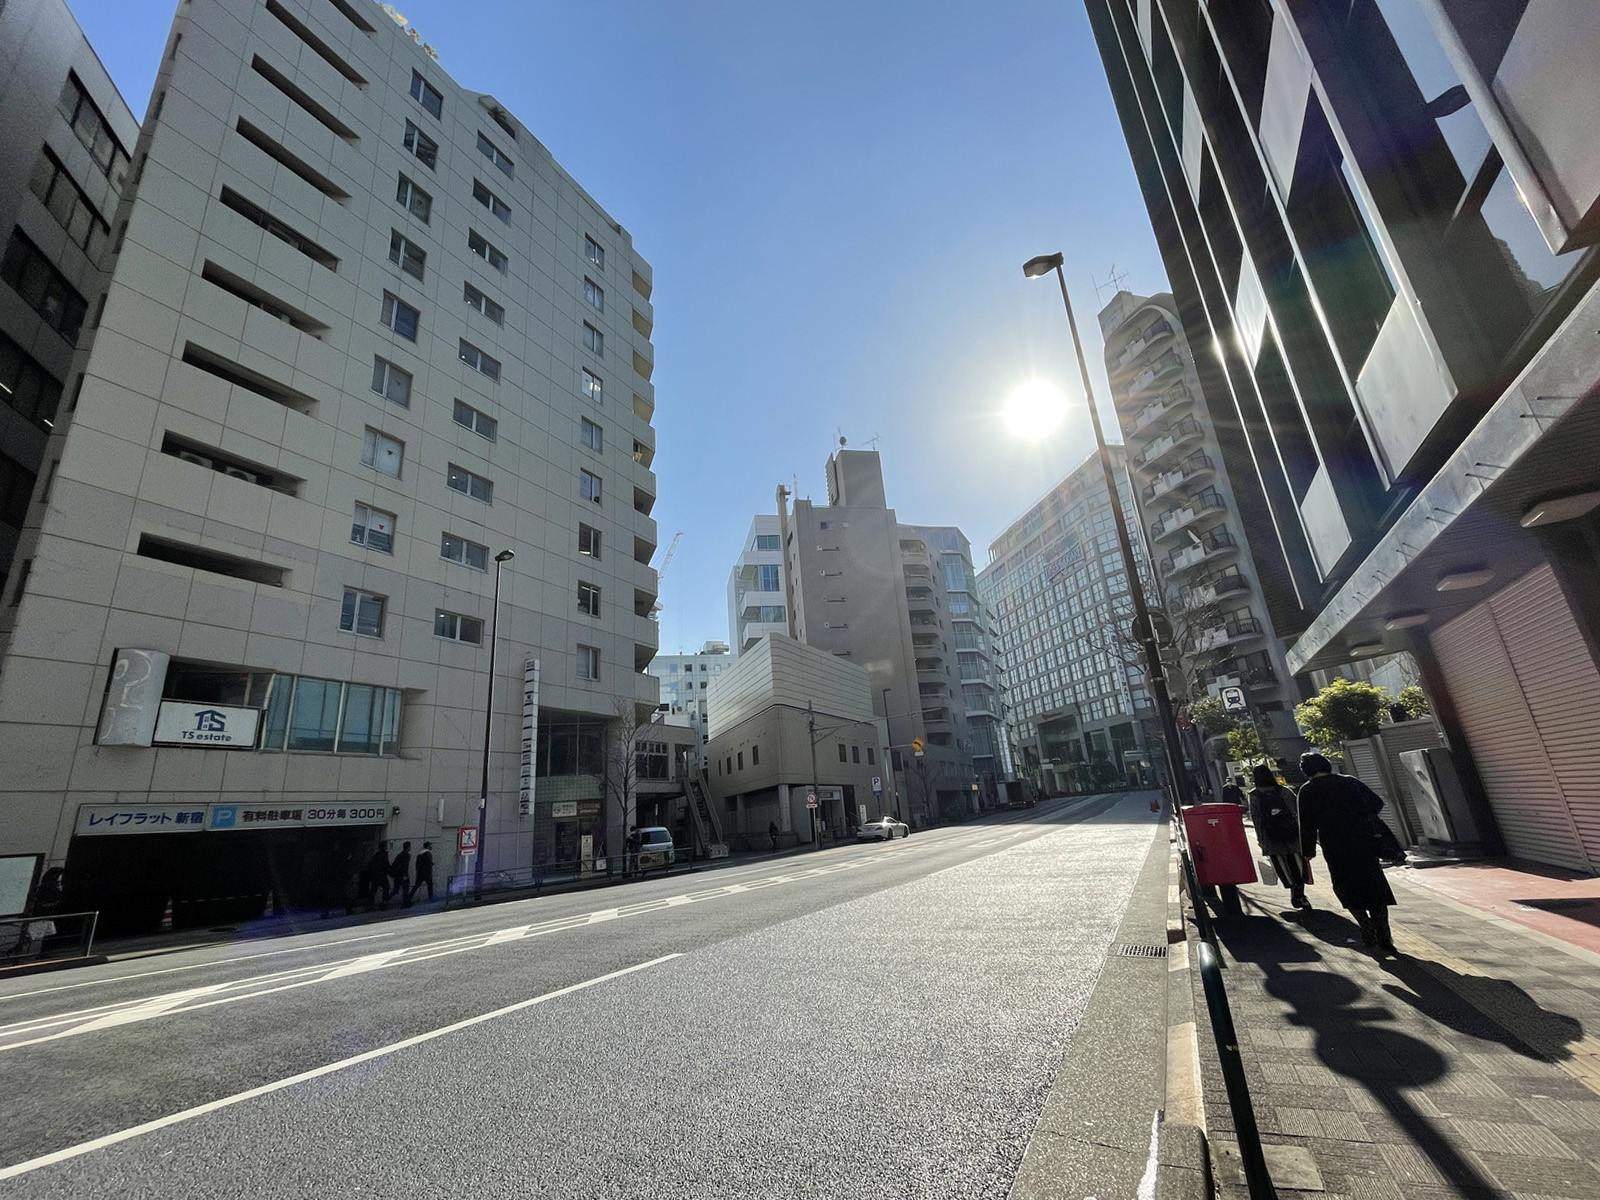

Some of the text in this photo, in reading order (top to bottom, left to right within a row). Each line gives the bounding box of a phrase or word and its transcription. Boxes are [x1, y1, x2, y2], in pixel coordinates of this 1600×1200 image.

[182, 731, 232, 742] TS estate
[89, 811, 205, 825] レイフラット 新宿
[217, 810, 232, 823] P
[242, 808, 385, 822] 有料駐車場 30分毎 300円
